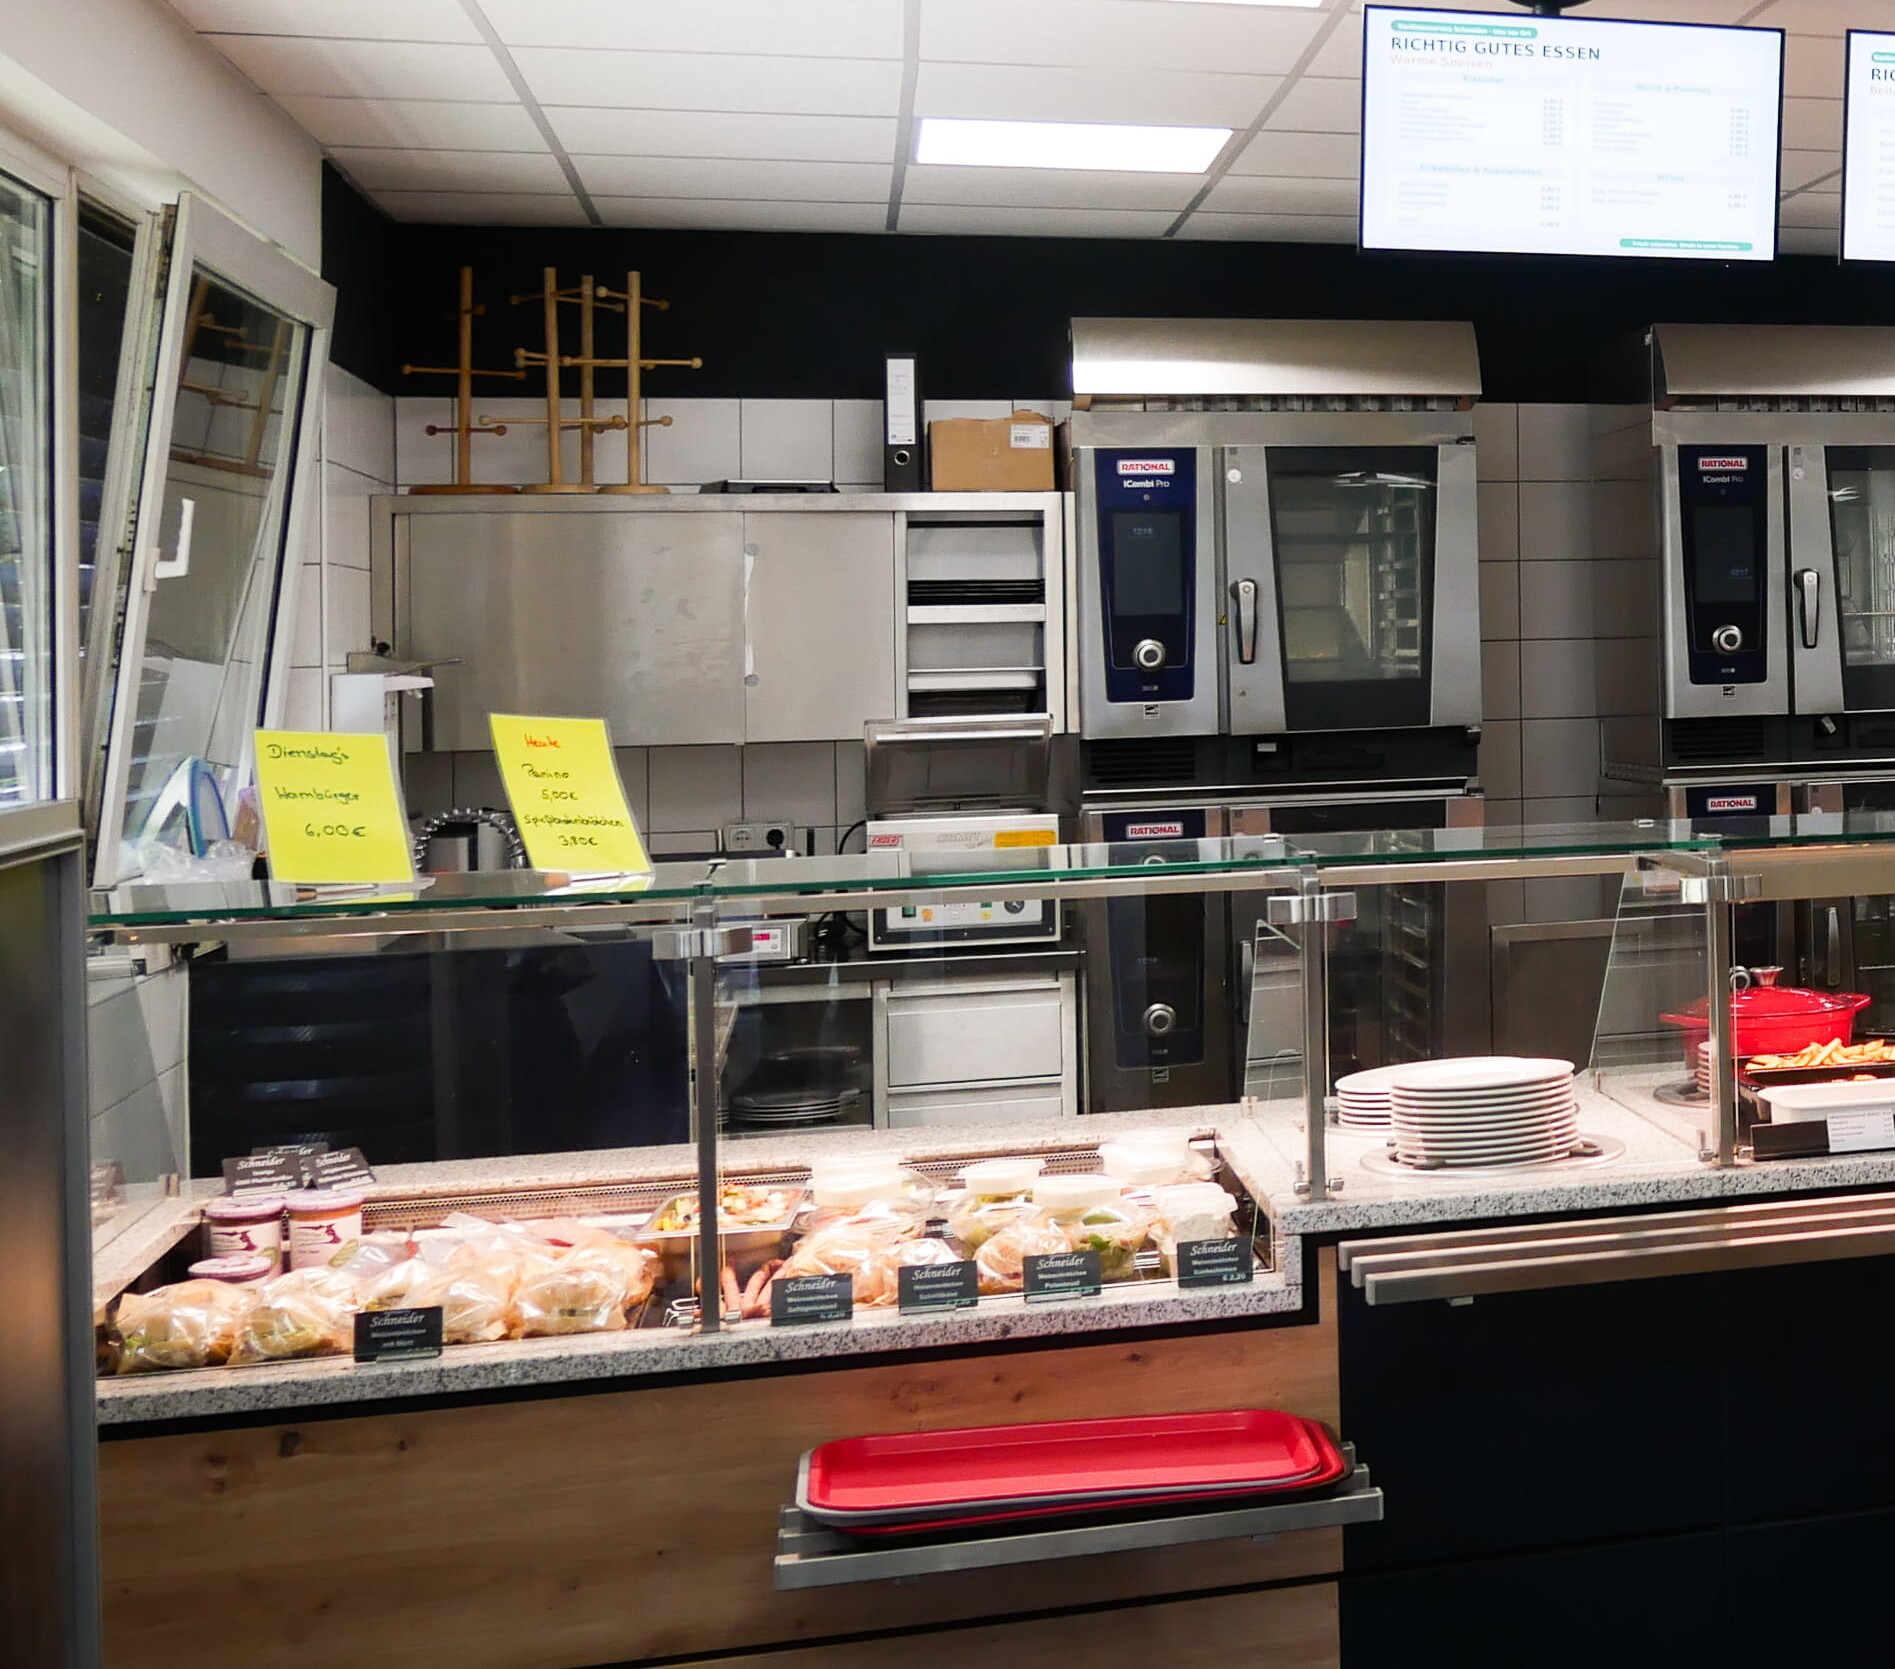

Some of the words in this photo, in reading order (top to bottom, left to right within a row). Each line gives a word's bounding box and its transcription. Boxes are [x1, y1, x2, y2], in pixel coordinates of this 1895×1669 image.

[1392, 37, 1467, 54] RICHTIG
[1475, 41, 1535, 57] GUTES
[1543, 45, 1600, 61] ESSEN
[1390, 55, 1437, 67] Warme
[1440, 58, 1494, 71] Speisen
[1121, 463, 1171, 471] RATIONAL
[1701, 459, 1745, 468] RATIONAL
[1155, 479, 1170, 488] Pro
[523, 733, 561, 749] Heute
[1710, 799, 1754, 808] RATIONAL
[1130, 826, 1180, 835] RATIONAL
[1189, 1241, 1238, 1257] Schneider
[1036, 1254, 1086, 1270] Schneider
[912, 1264, 963, 1281] Schneider
[784, 1277, 837, 1294] Schneider
[369, 1311, 426, 1328] Schneider
